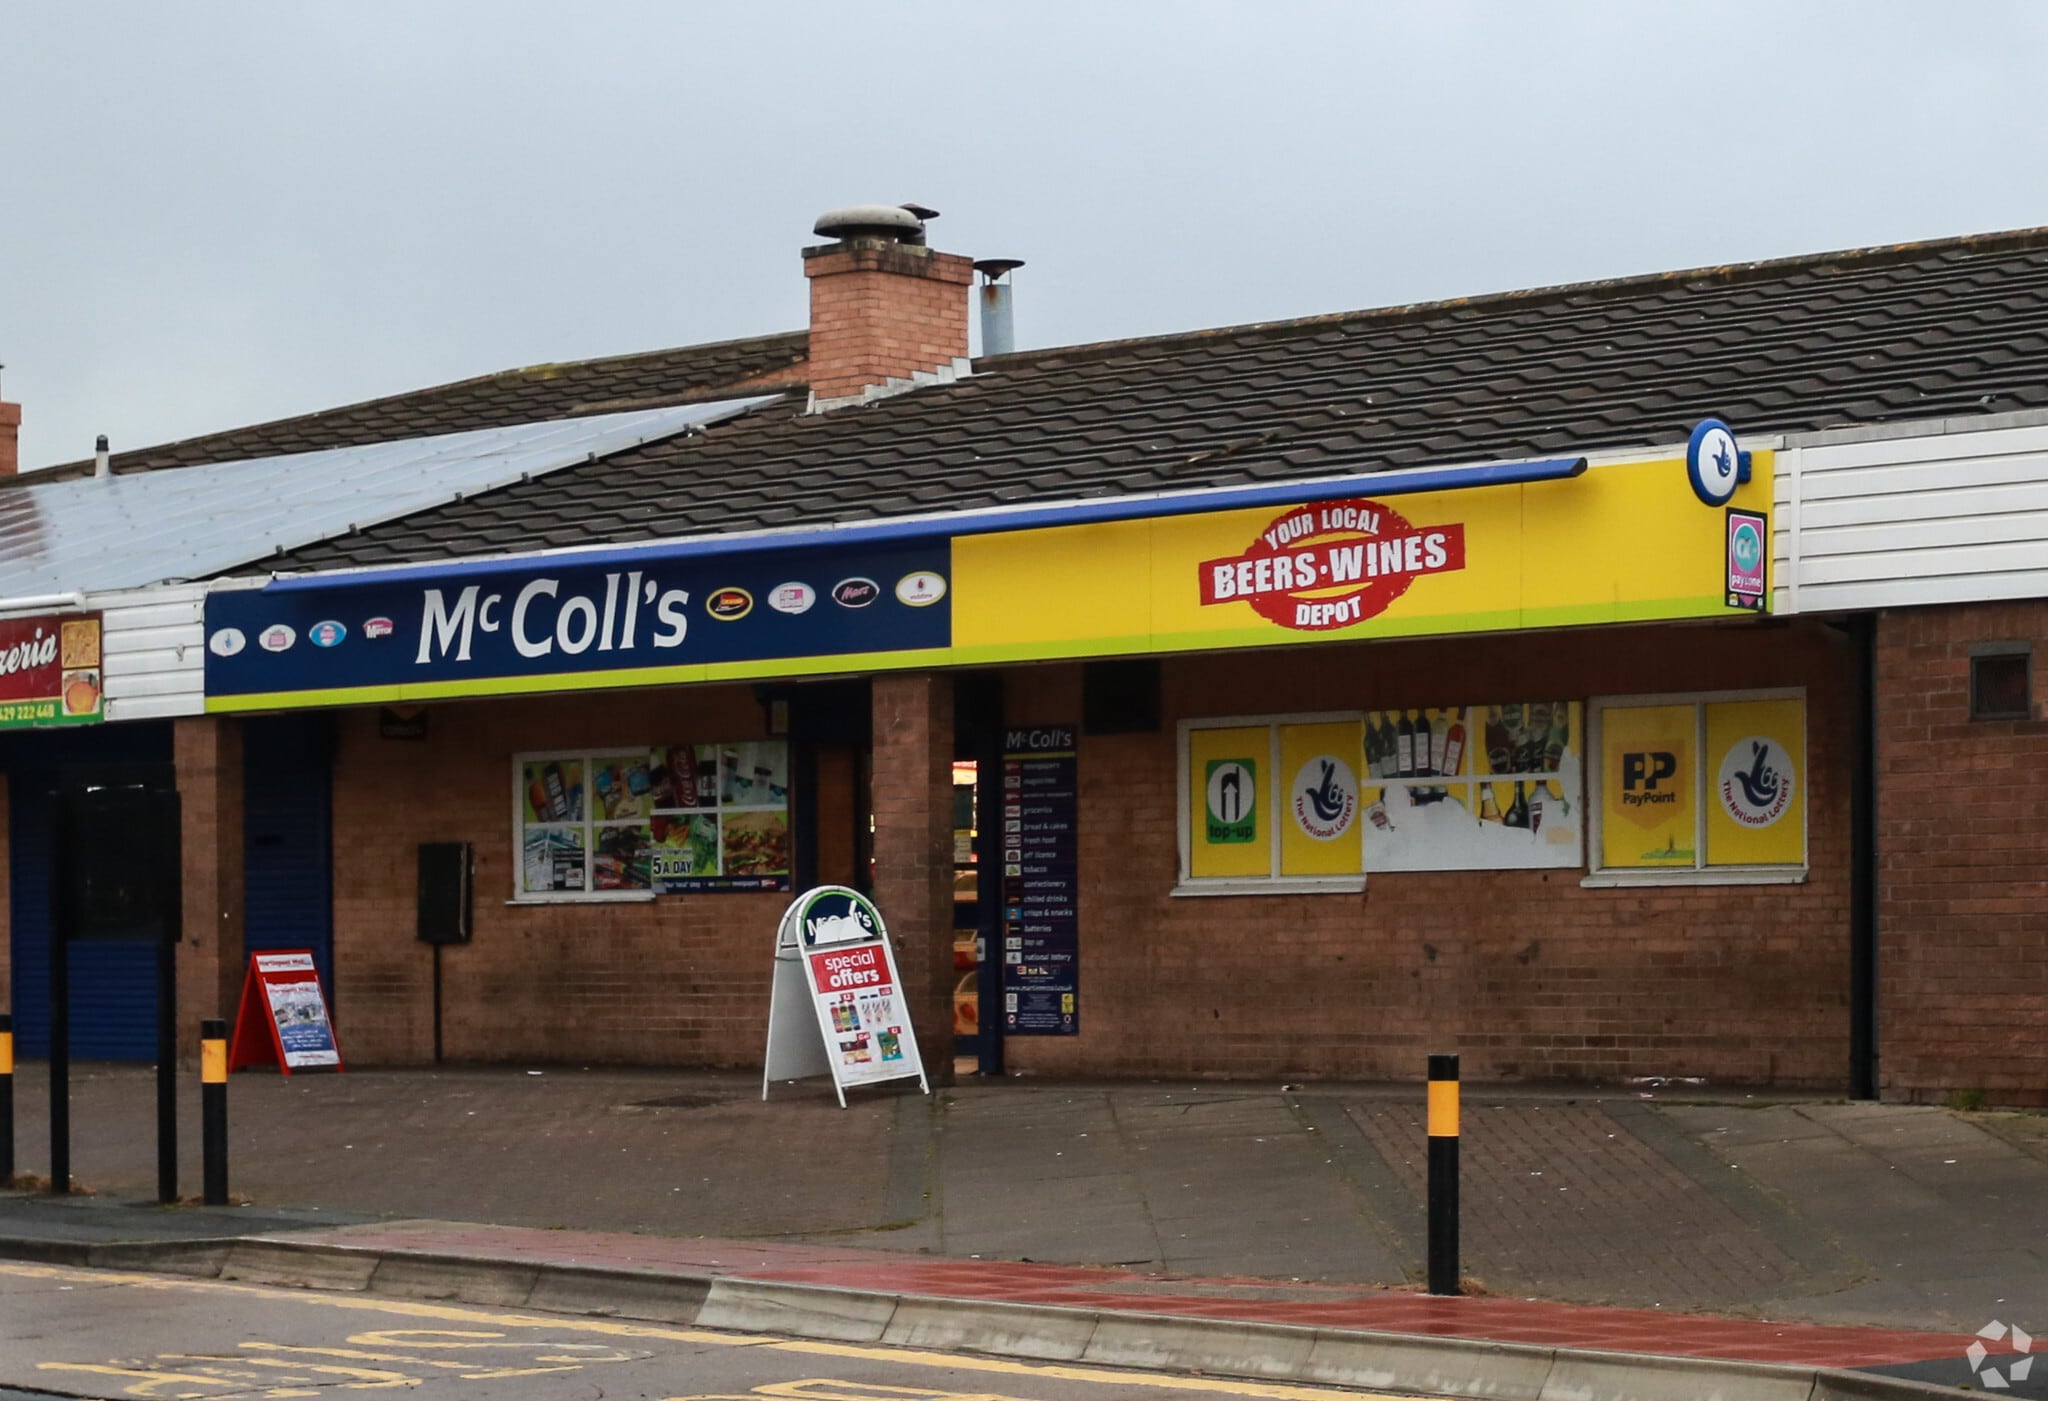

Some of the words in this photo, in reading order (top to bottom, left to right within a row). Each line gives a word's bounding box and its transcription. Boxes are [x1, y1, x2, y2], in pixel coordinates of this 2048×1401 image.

[1264, 512, 1314, 551] YOUR
[1322, 507, 1380, 535] LOCAL
[415, 571, 690, 665] McColl's
[1296, 596, 1361, 626] DEPOT
[1006, 729, 1072, 749] McColl's
[1623, 791, 1676, 808] PayPoint
[1731, 802, 1768, 825] National
[1768, 777, 1791, 818] Lottery
[1301, 817, 1336, 838] National
[1336, 794, 1354, 832] Lottery
[1209, 824, 1253, 840] top-up
[653, 857, 662, 875] 5
[663, 862, 670, 874] A
[673, 861, 692, 874] DAY
[825, 949, 876, 973] special
[829, 967, 880, 988] offers
